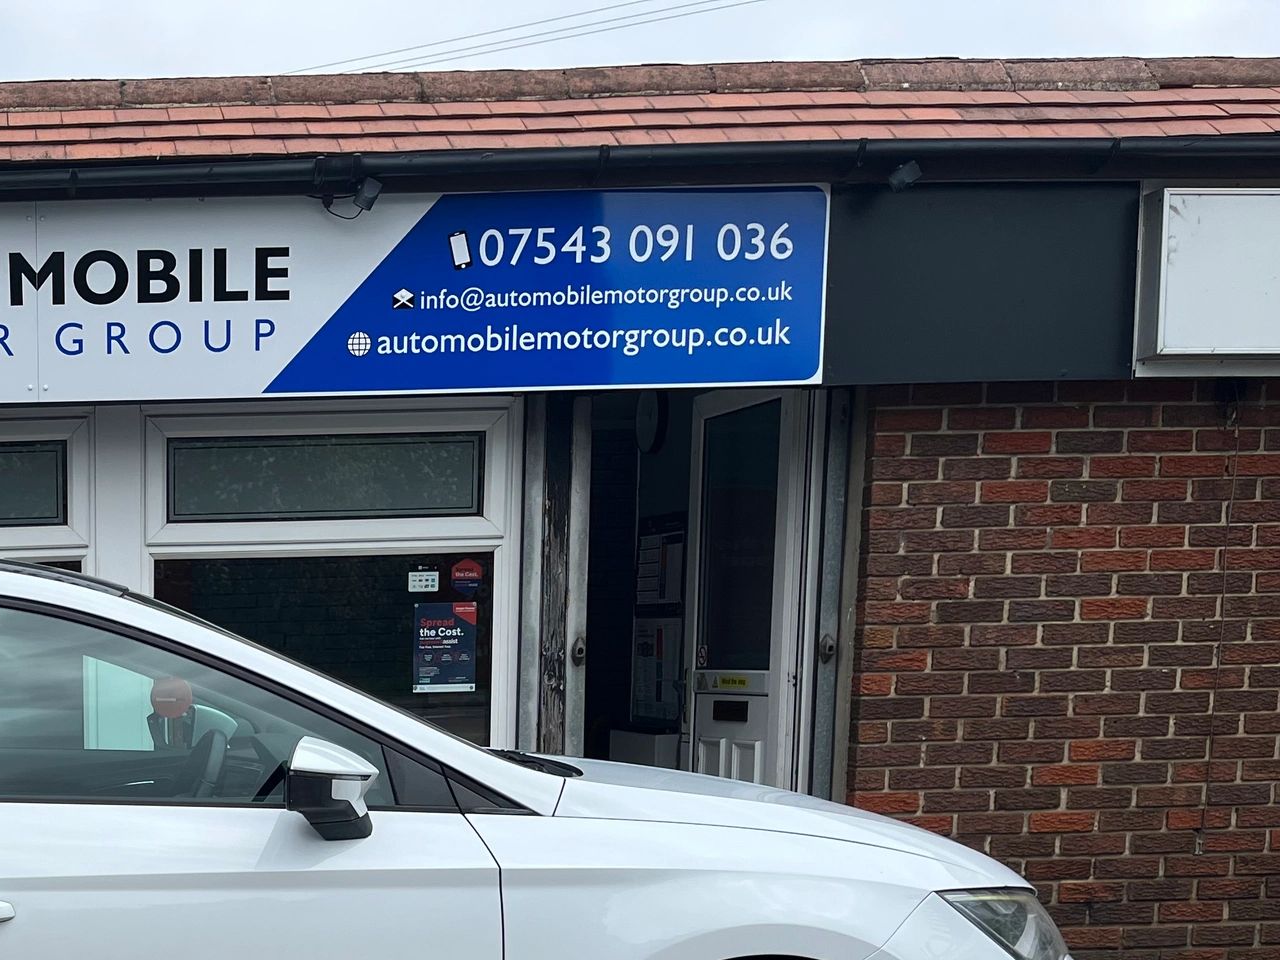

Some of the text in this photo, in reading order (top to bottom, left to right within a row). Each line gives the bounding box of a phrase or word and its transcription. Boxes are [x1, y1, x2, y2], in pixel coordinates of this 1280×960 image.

[479, 222, 794, 267] 07543 091 036
[9, 246, 290, 306] MOBILE
[420, 281, 793, 312] info@automobilemotorgroup.co.uk
[55, 319, 276, 356] GROUP
[377, 319, 791, 356] automobilemotorgroup.co.uk
[419, 627, 464, 637] the Cost.
[420, 618, 455, 628] Spread
